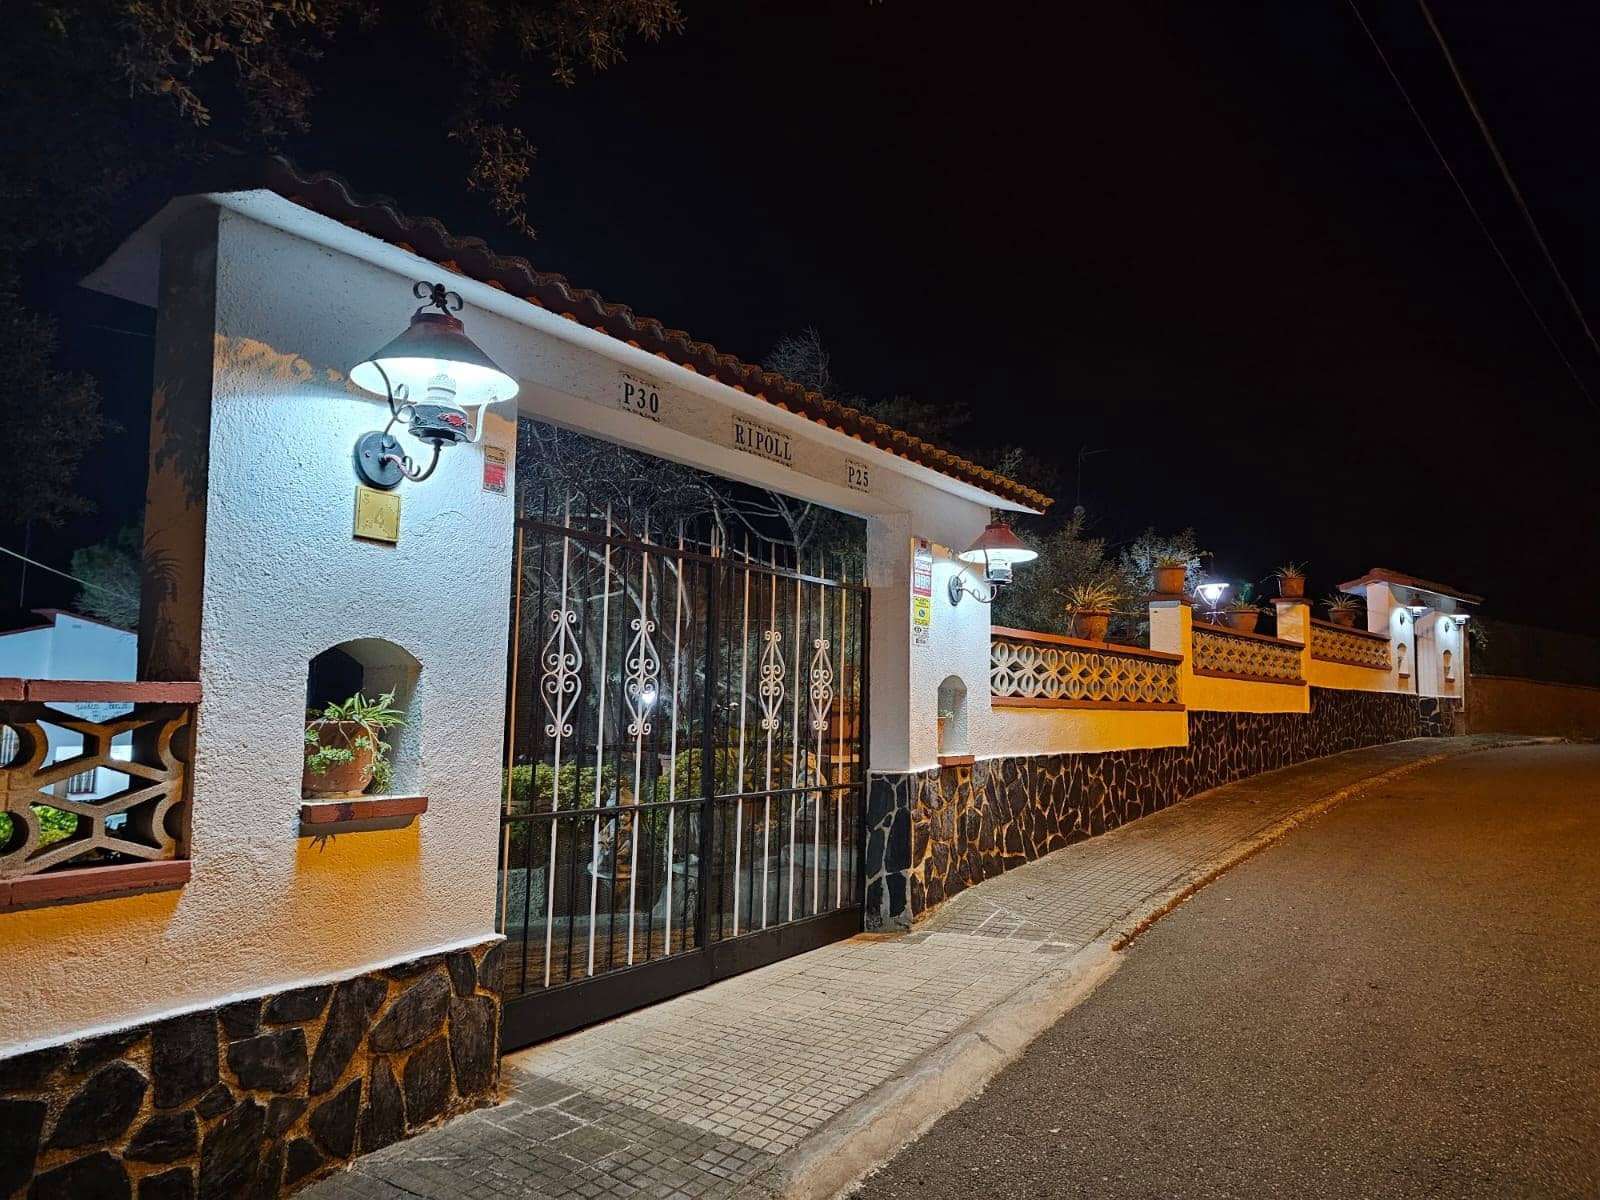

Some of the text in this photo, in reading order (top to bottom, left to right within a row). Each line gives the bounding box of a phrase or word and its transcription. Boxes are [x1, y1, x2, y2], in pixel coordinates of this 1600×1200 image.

[623, 382, 660, 414] P30
[734, 424, 793, 461] RIPOLL
[848, 466, 869, 488] P25
